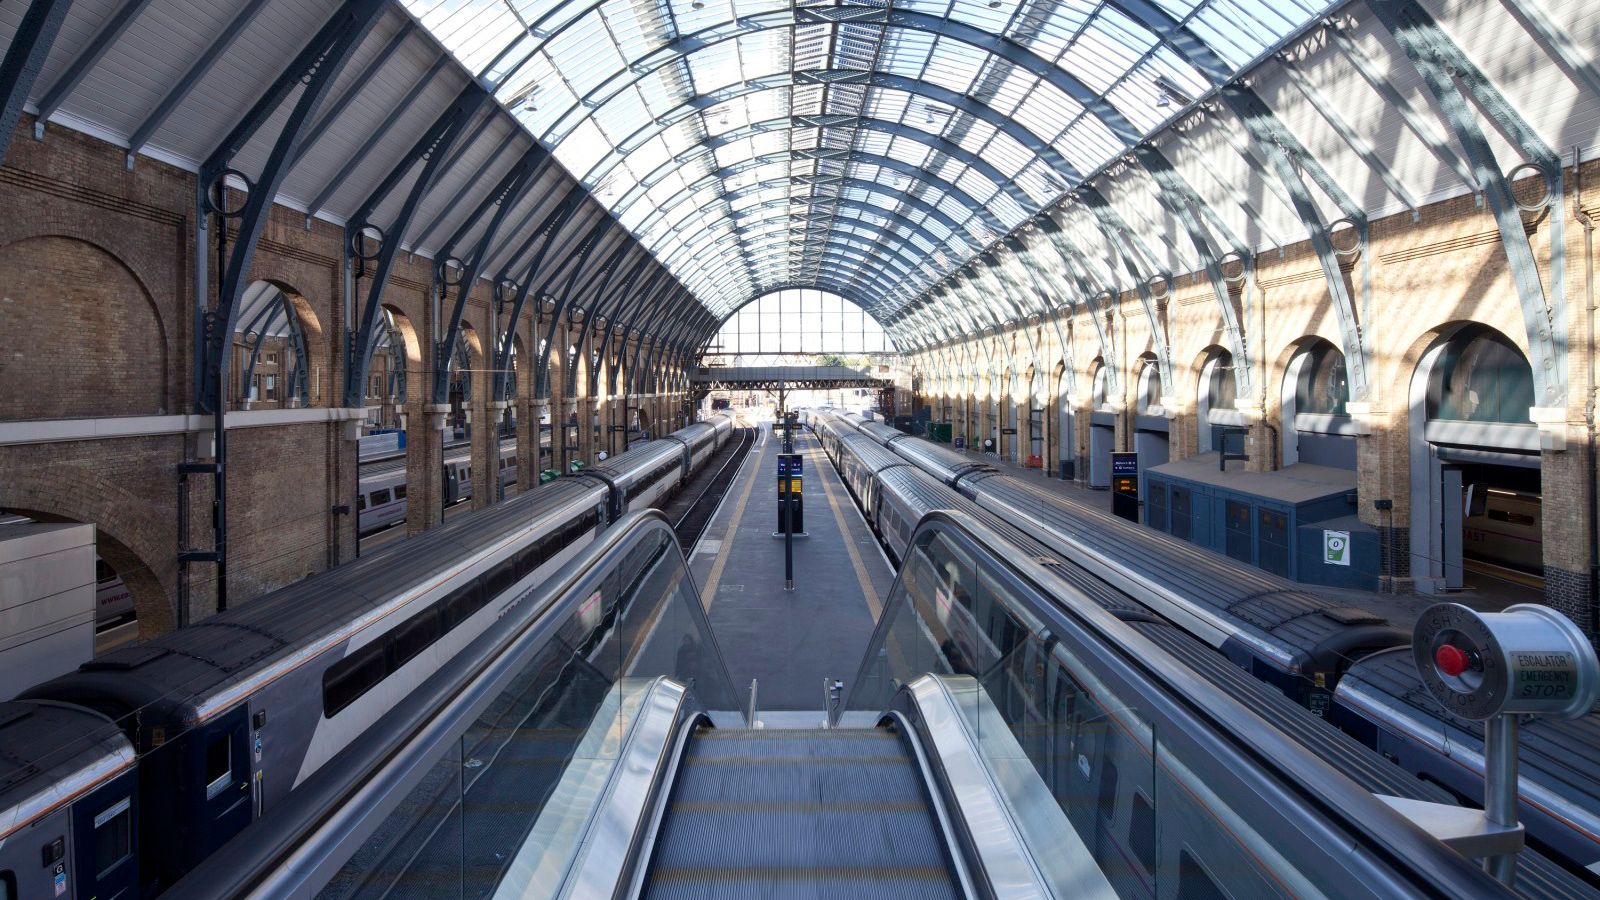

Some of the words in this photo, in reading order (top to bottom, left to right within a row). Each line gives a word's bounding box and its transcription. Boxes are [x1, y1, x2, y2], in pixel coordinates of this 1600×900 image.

[1518, 655, 1568, 667] ESCALATOR
[1520, 670, 1570, 682] EMERGENCY
[1522, 684, 1566, 697] STOP
